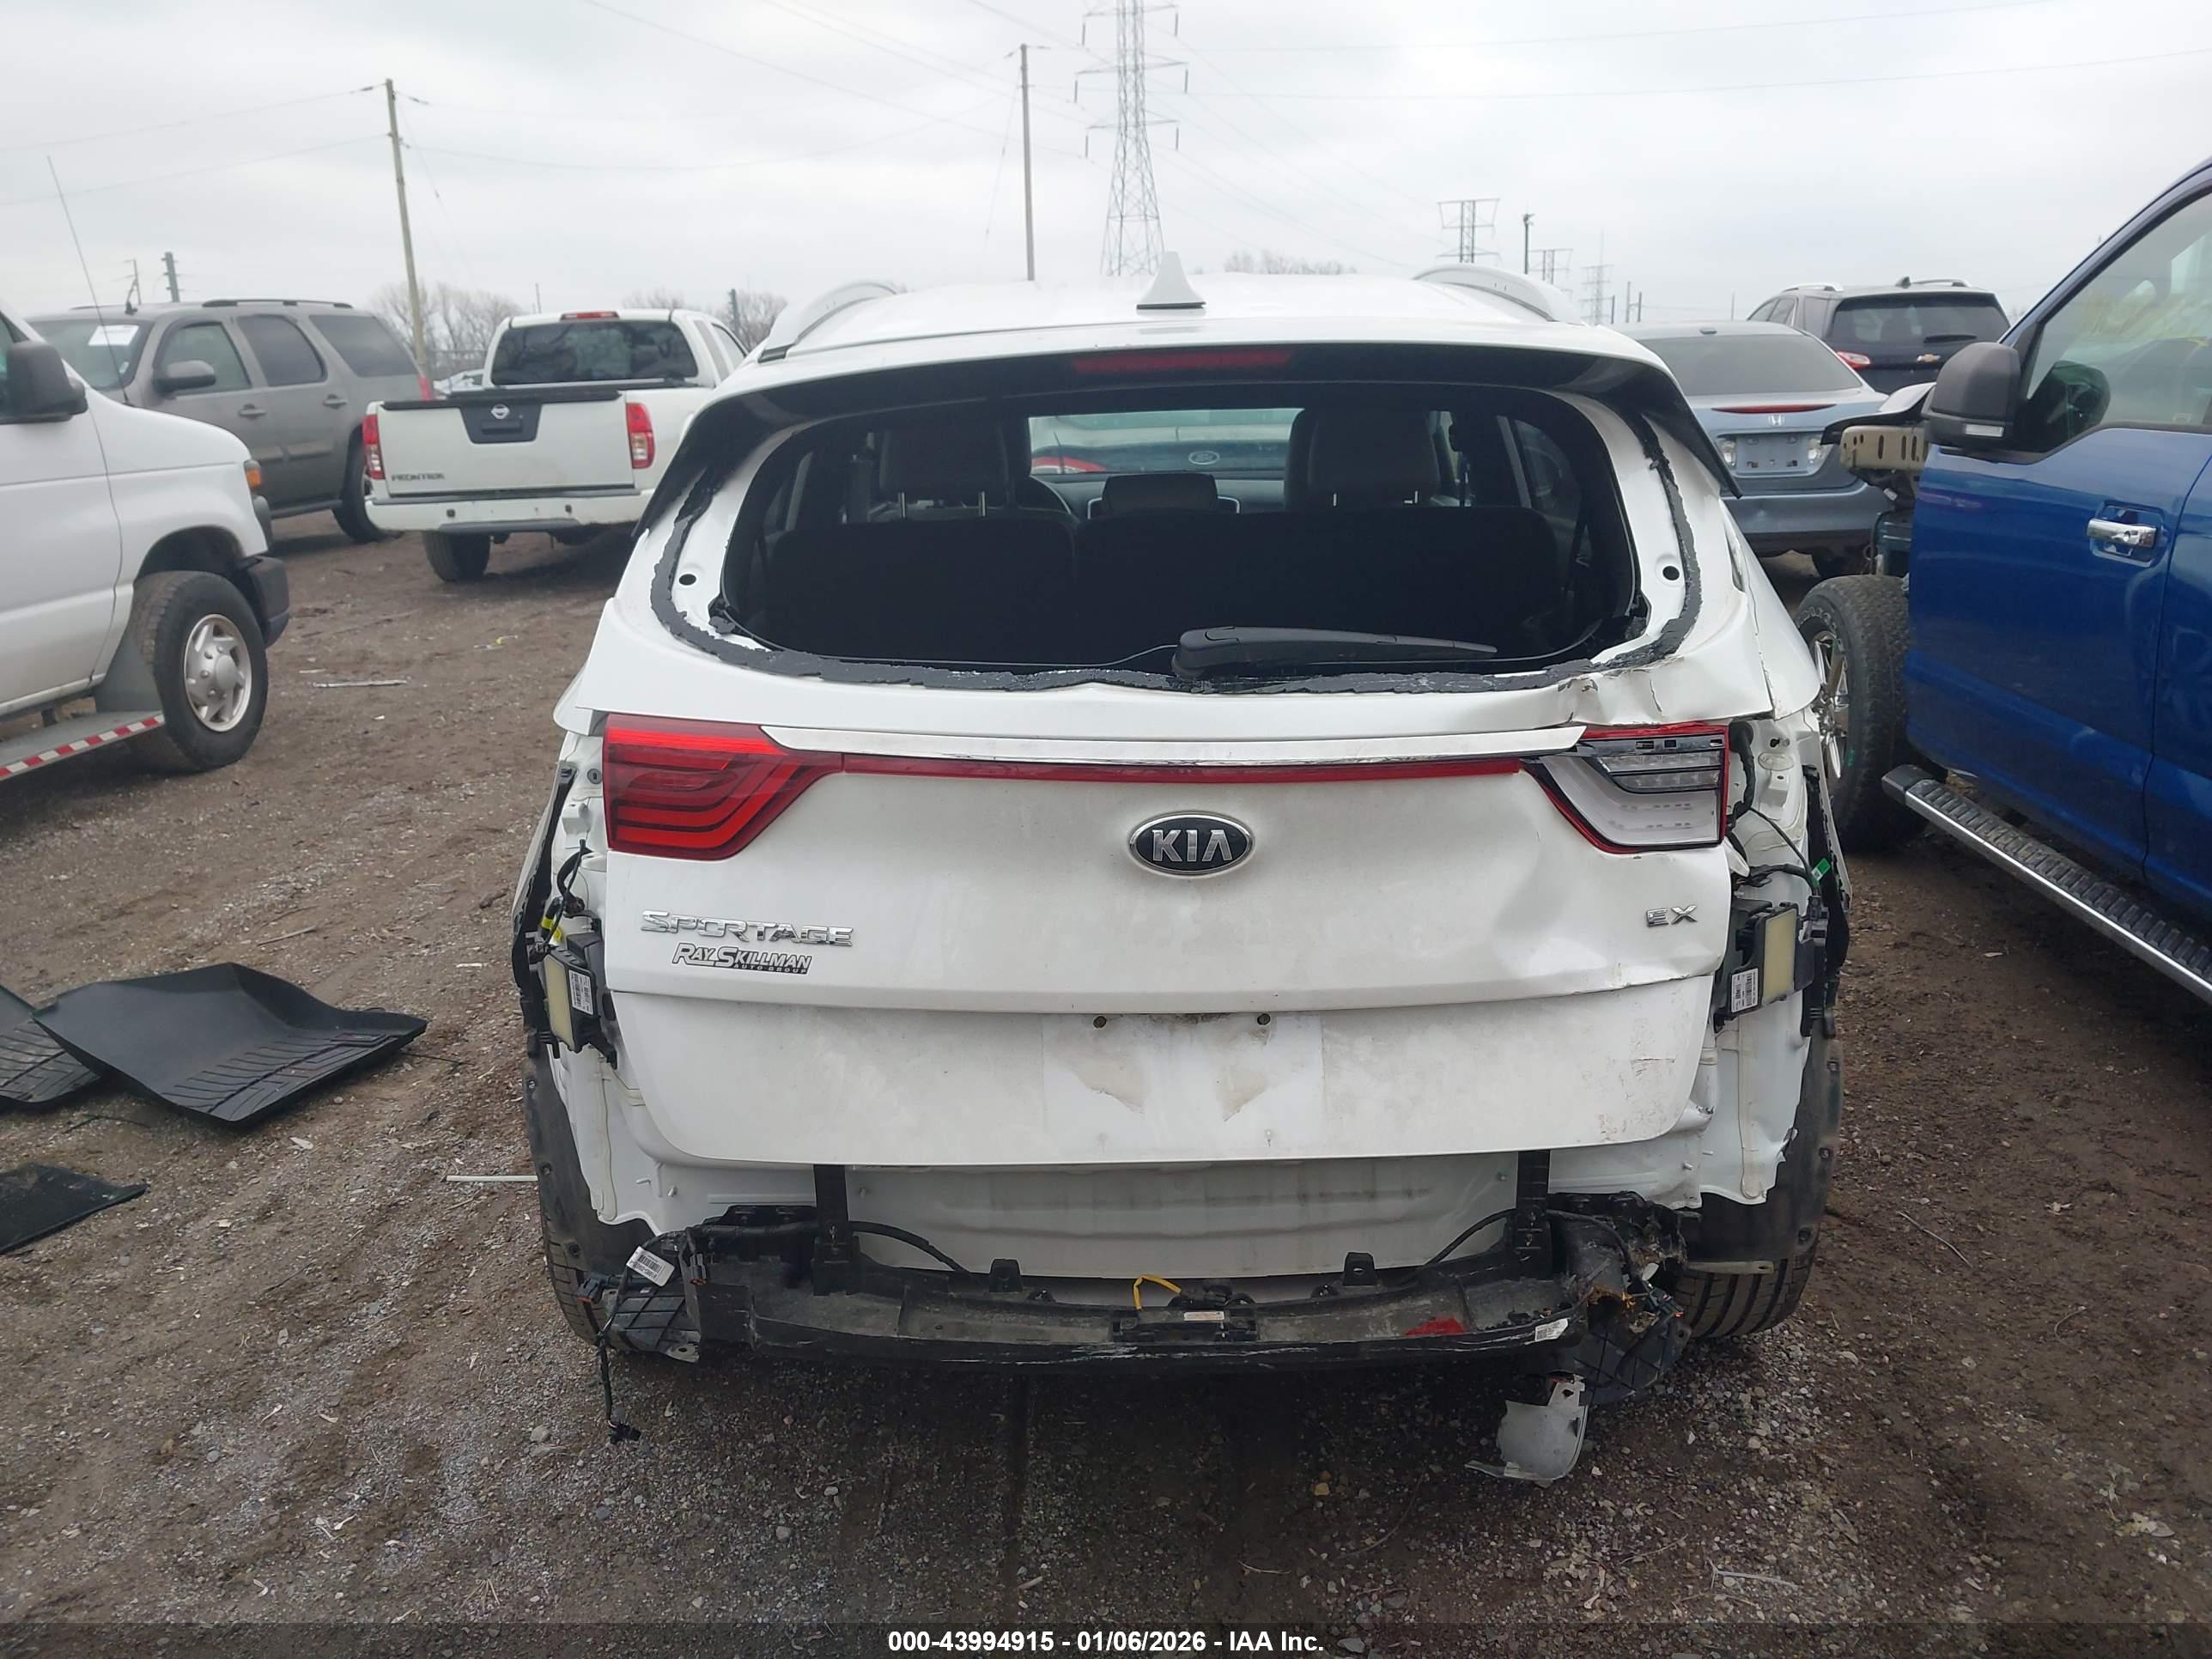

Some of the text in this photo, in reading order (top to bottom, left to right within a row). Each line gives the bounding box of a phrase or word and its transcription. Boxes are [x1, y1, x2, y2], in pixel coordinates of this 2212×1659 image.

[1152, 829, 1233, 862] KIA
[641, 910, 853, 946] SPORTAGE
[1646, 904, 1698, 927] EX
[672, 942, 812, 970] RAY SKILLMAN
